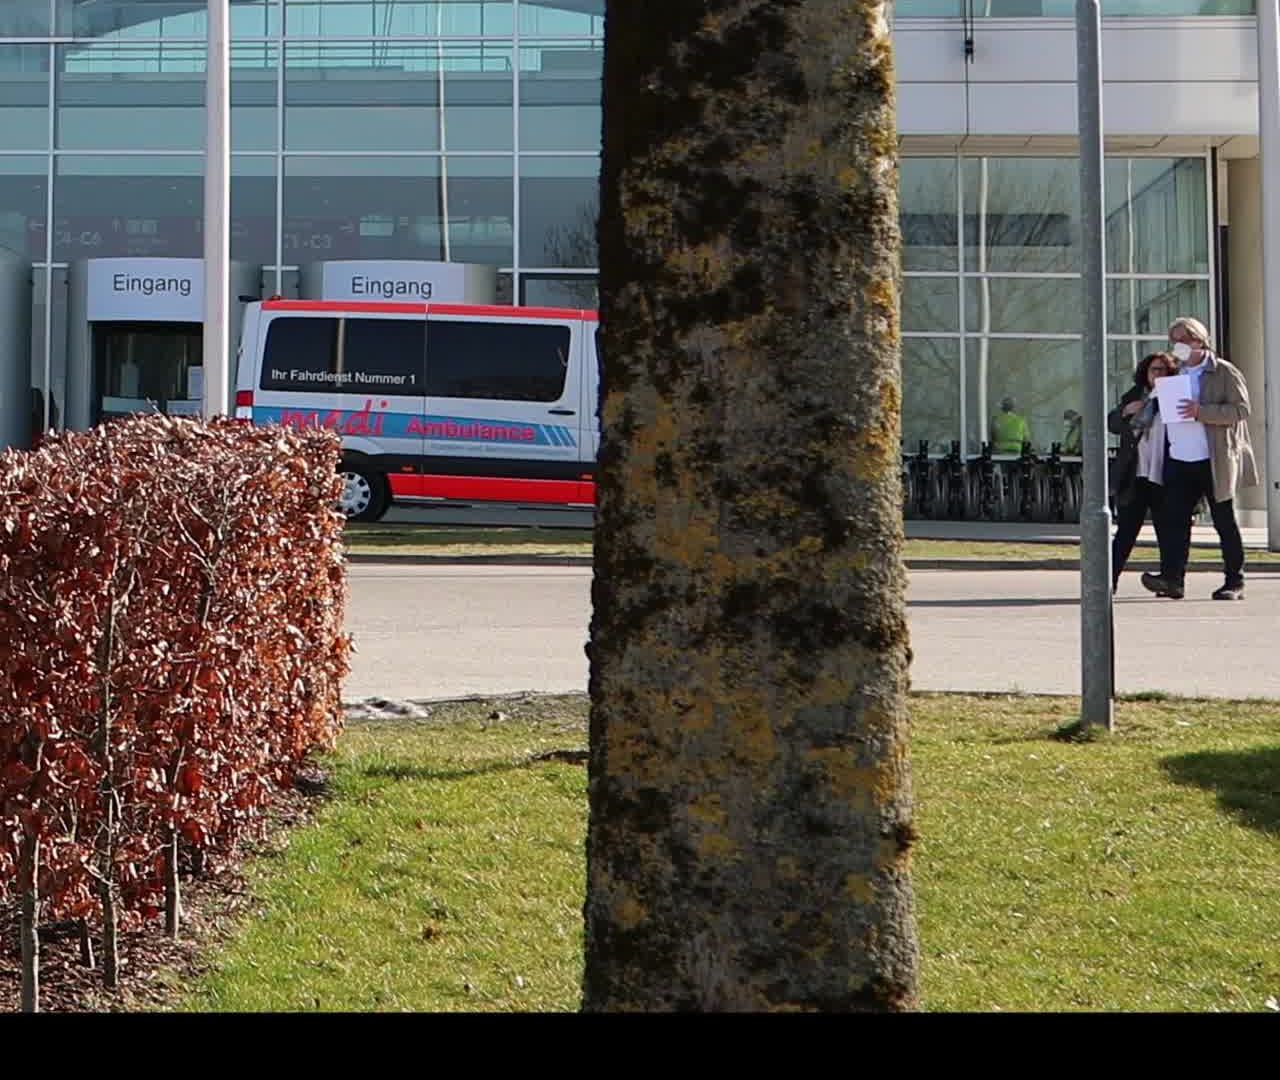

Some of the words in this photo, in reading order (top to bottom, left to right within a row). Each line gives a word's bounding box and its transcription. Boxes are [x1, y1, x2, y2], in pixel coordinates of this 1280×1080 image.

[113, 274, 192, 296] Eingang
[351, 276, 433, 299] Eingang
[271, 369, 287, 382] Ihr
[290, 370, 353, 384] Fahrdienst
[355, 371, 405, 385] Nummer
[407, 373, 415, 385] 1
[405, 417, 536, 442] Ambulance
